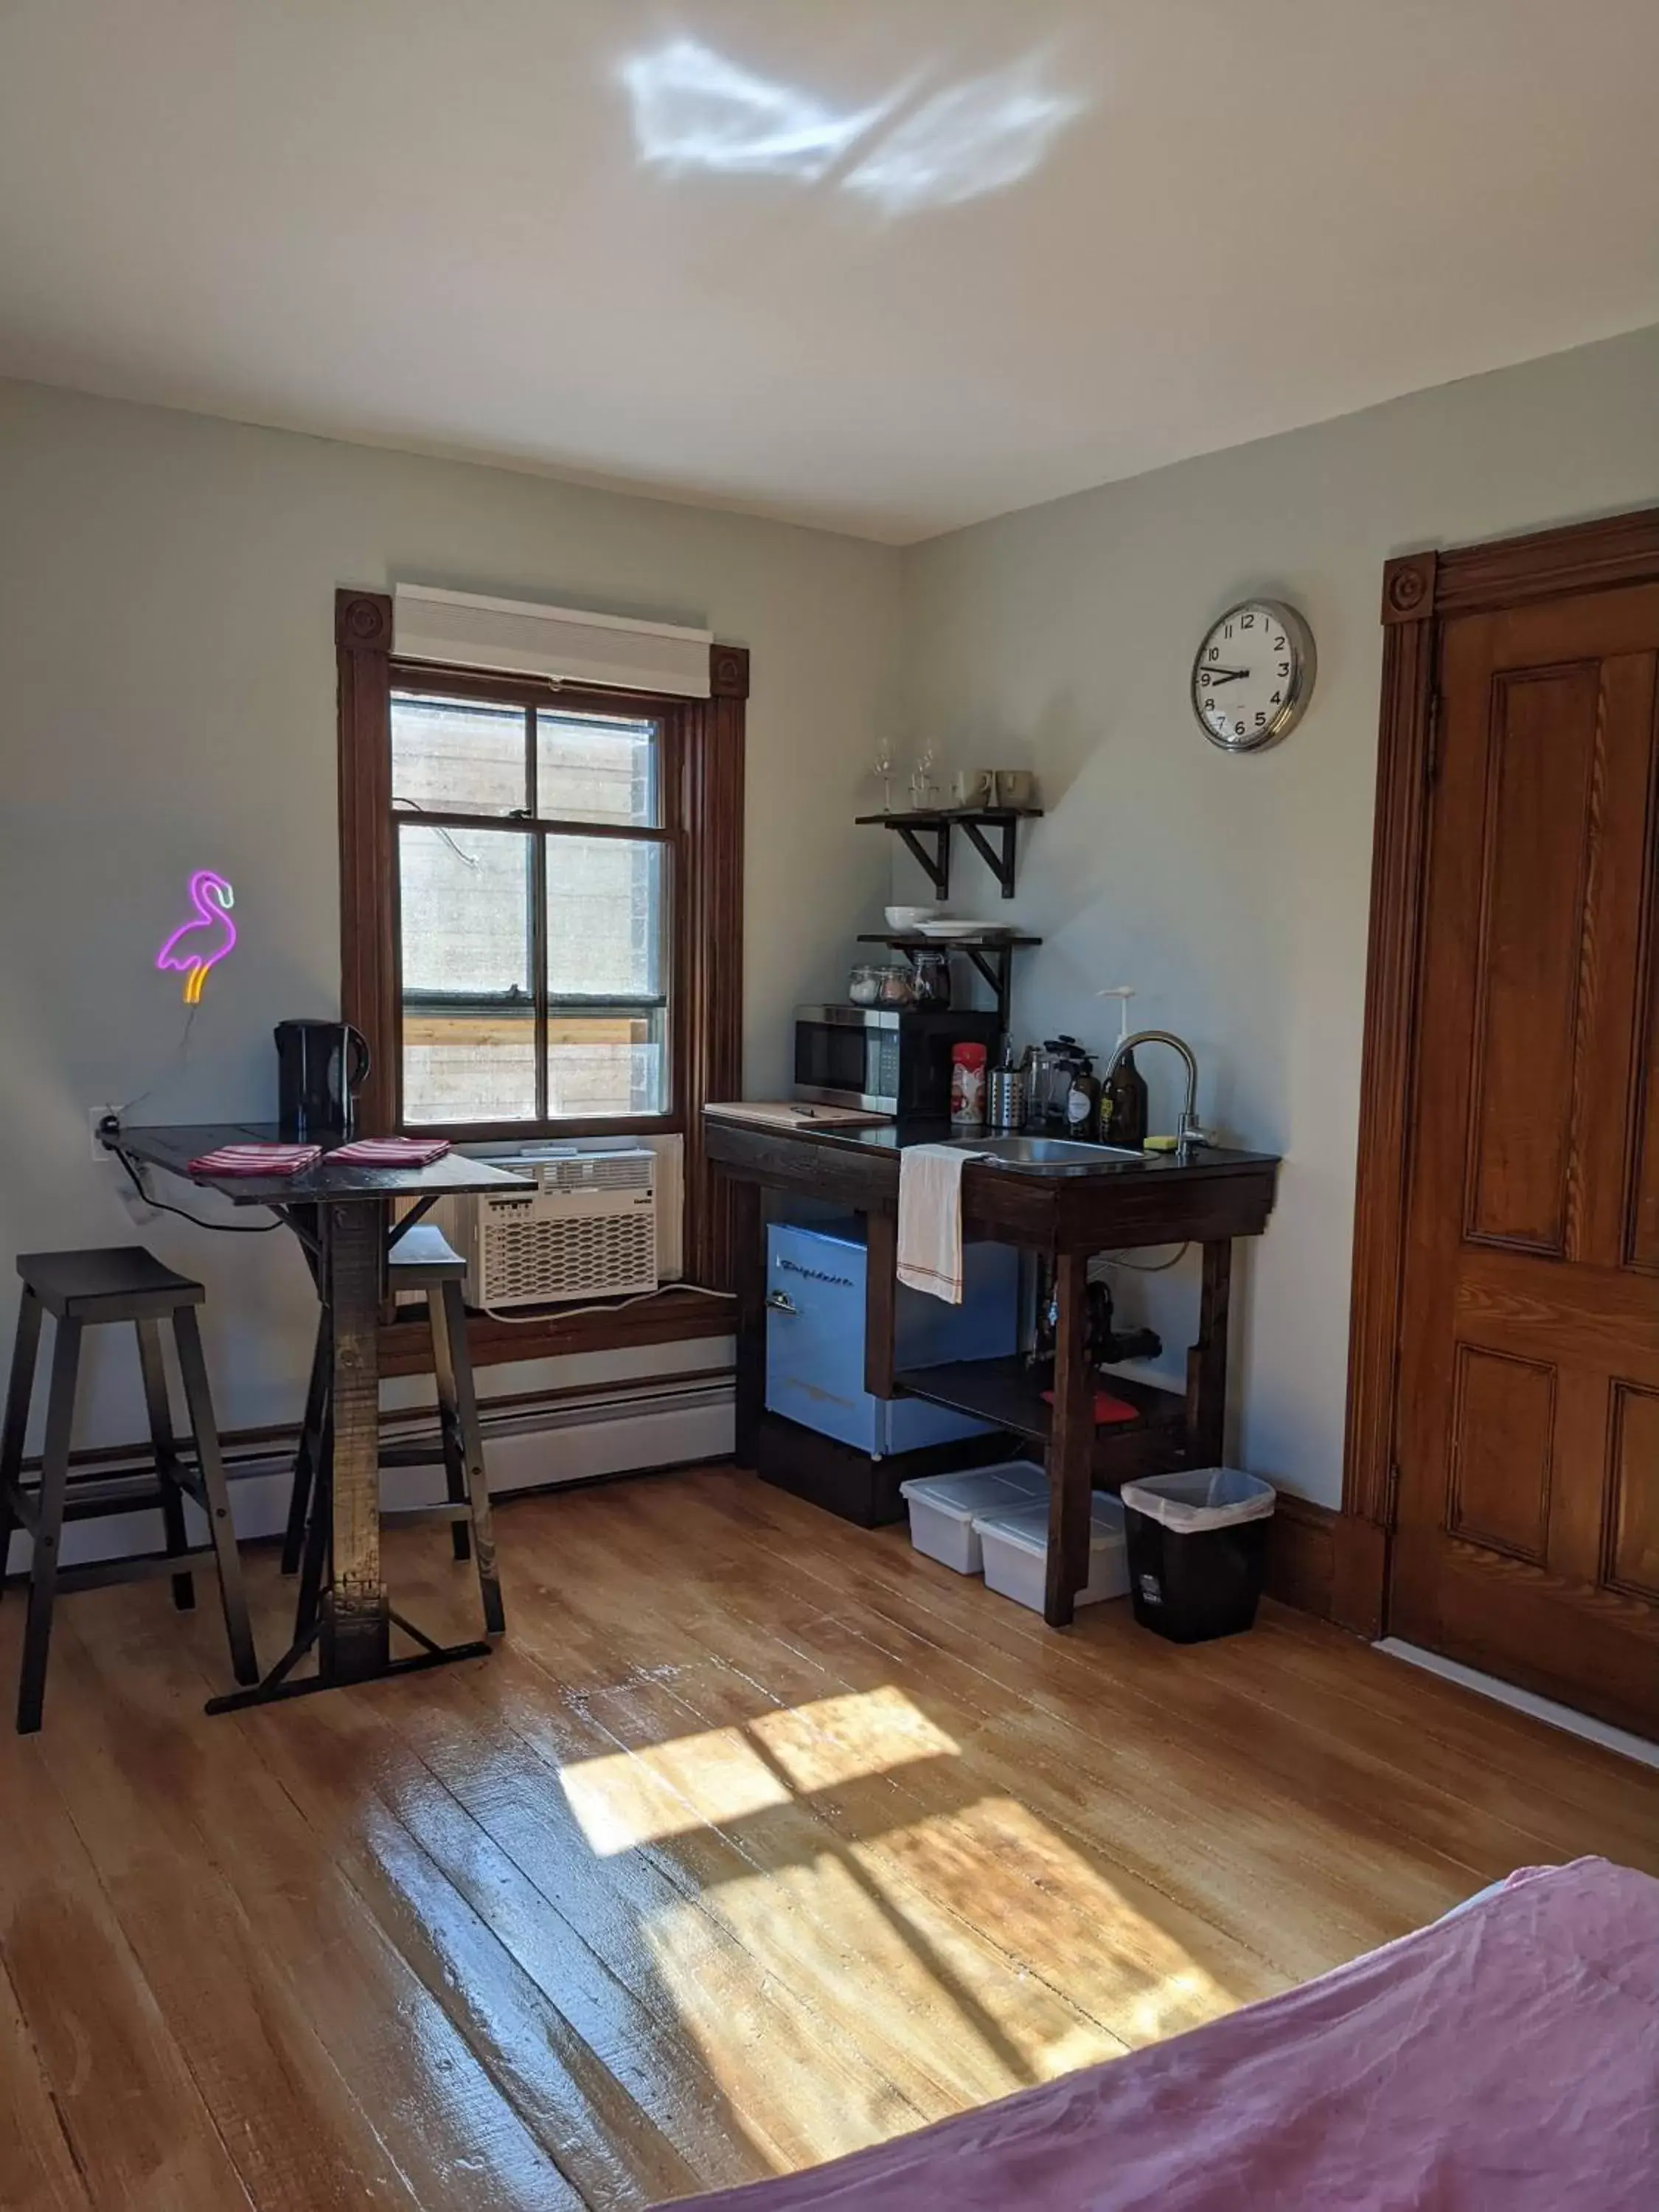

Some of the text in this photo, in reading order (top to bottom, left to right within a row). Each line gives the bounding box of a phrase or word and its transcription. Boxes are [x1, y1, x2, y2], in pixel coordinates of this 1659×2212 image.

[1240, 614, 1254, 629] 12
[1265, 619, 1269, 633] 1
[1225, 625, 1232, 639] 11
[1273, 637, 1285, 650] 2
[1208, 647, 1220, 661] 10
[1277, 663, 1290, 678] 3
[1200, 673, 1211, 686] 9
[1270, 691, 1281, 705] 4
[1205, 699, 1214, 712] 8
[1217, 716, 1226, 729] 7
[1255, 712, 1266, 726] 5
[1235, 721, 1245, 735] 6
